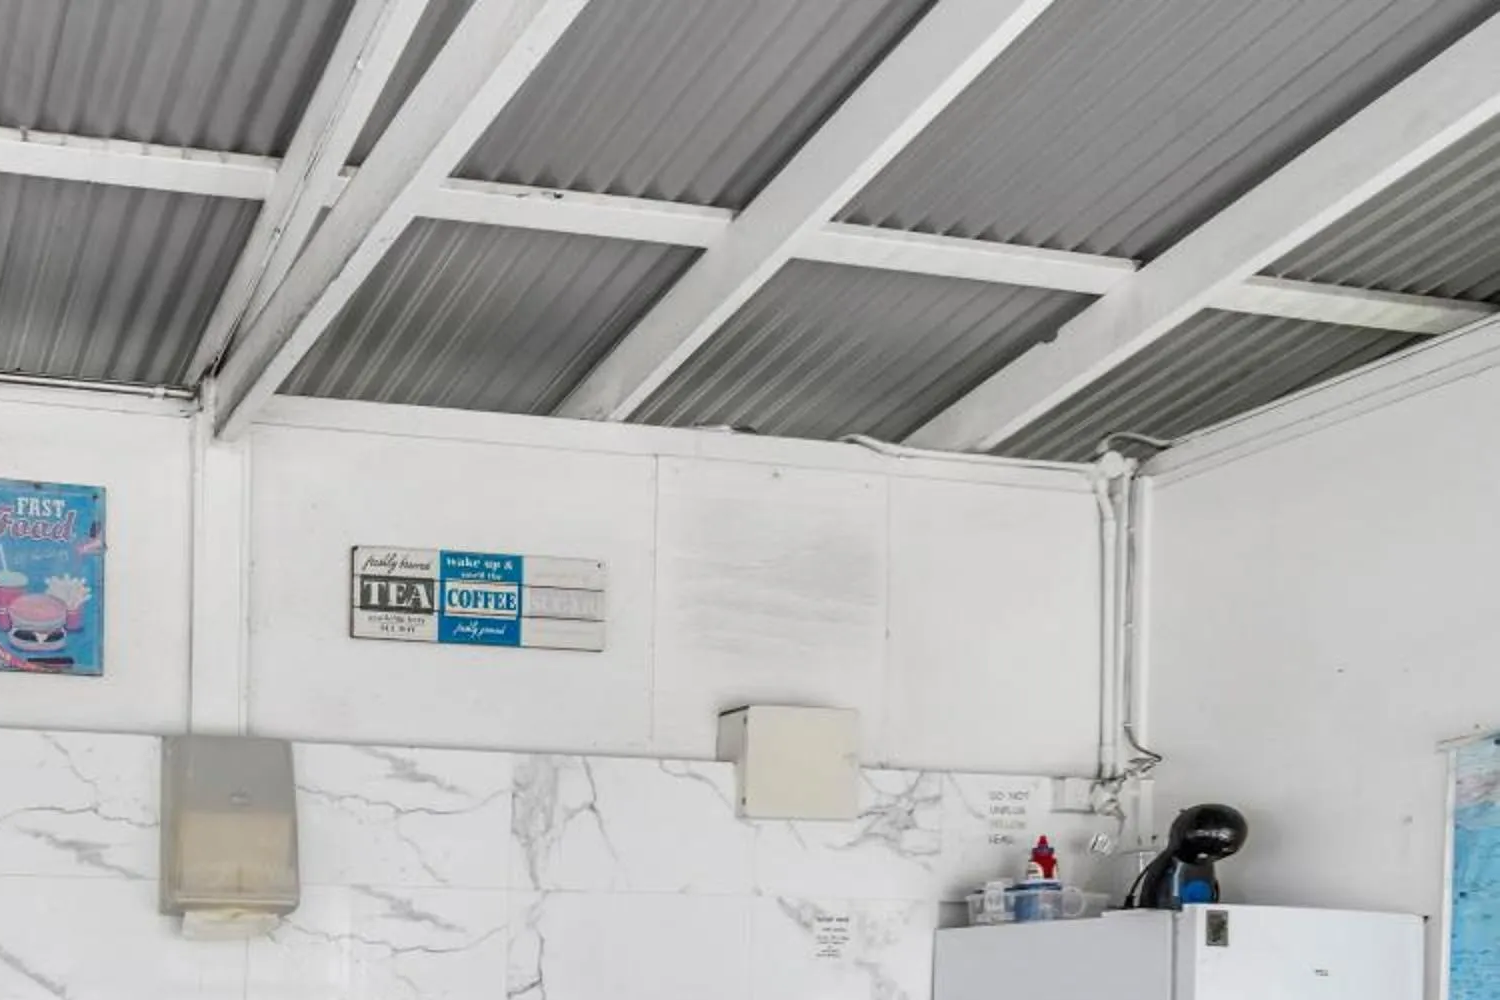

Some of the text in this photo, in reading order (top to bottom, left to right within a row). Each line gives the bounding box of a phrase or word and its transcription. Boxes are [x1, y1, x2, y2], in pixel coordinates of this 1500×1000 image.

[17, 496, 66, 519] FAST
[446, 556, 480, 569] wake
[484, 561, 501, 572] up
[362, 580, 432, 609] TEA
[446, 587, 517, 611] COFFEE
